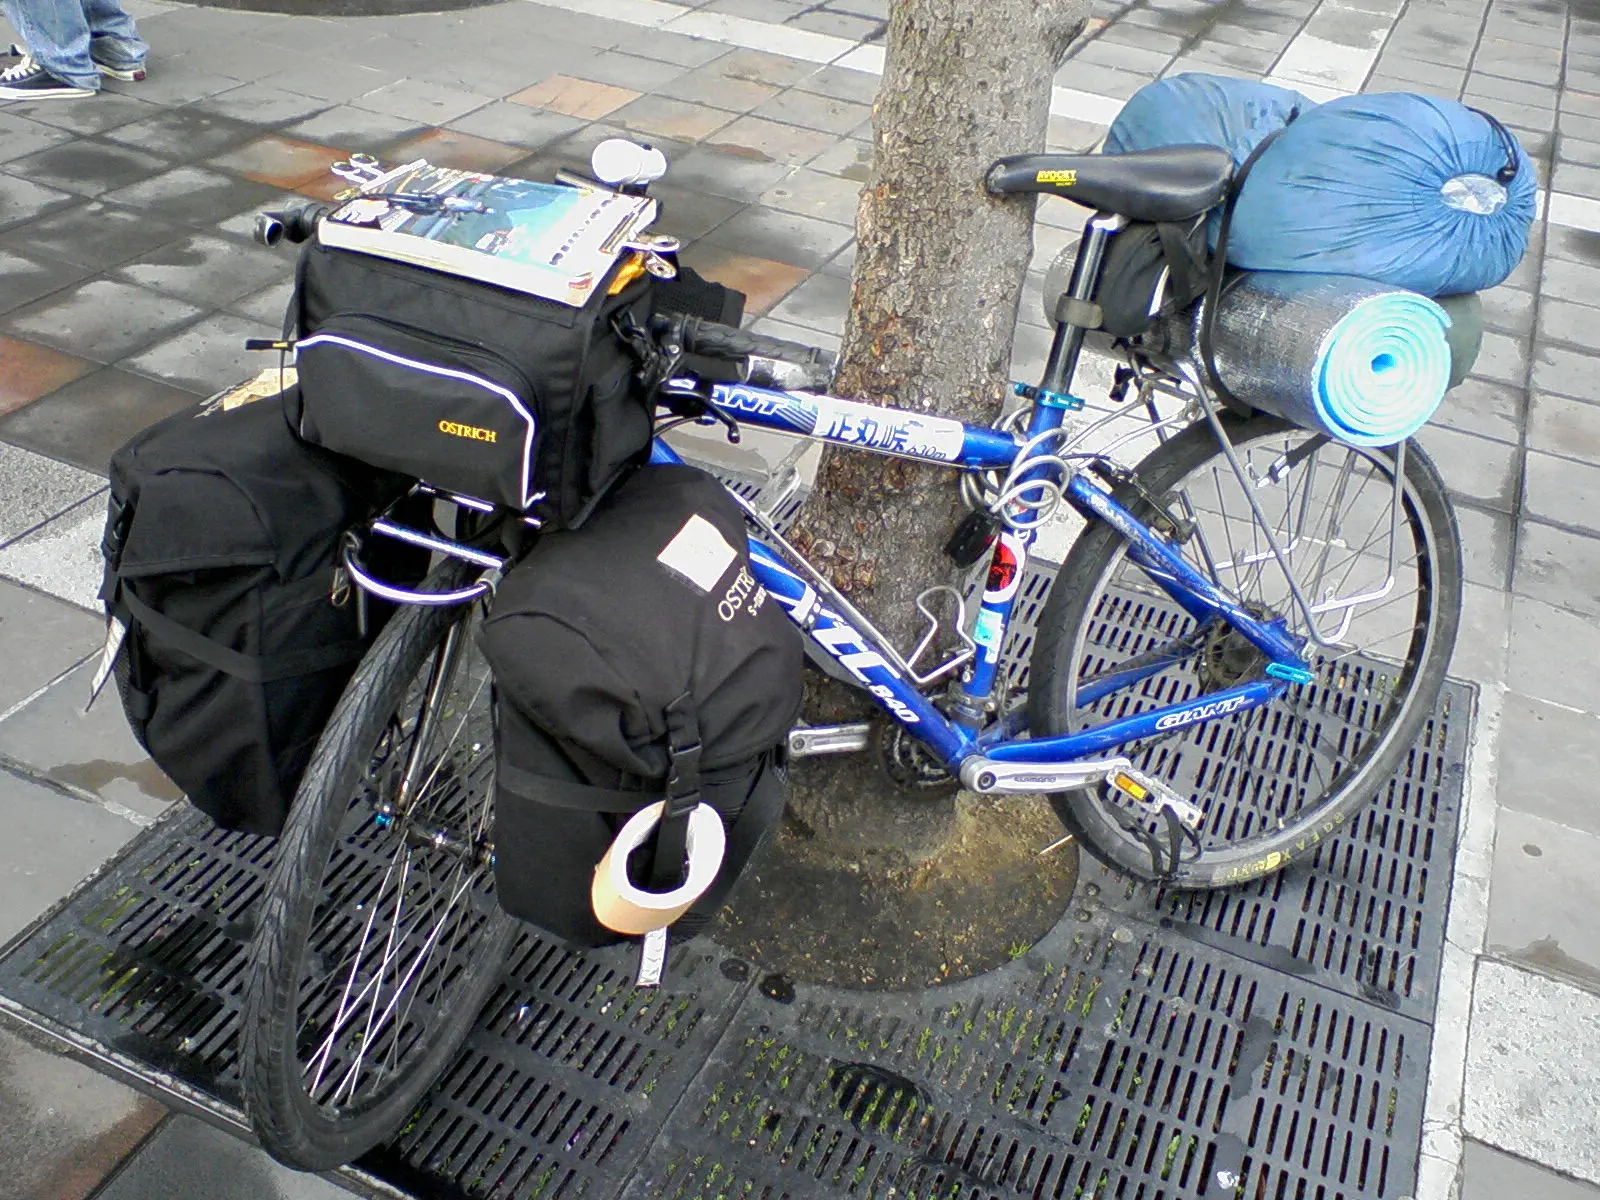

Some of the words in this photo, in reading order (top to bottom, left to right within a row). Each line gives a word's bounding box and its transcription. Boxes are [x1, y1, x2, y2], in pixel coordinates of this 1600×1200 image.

[438, 420, 497, 443] OSTRICH
[717, 565, 755, 622] OSTR
[1155, 695, 1247, 730] GIANT
